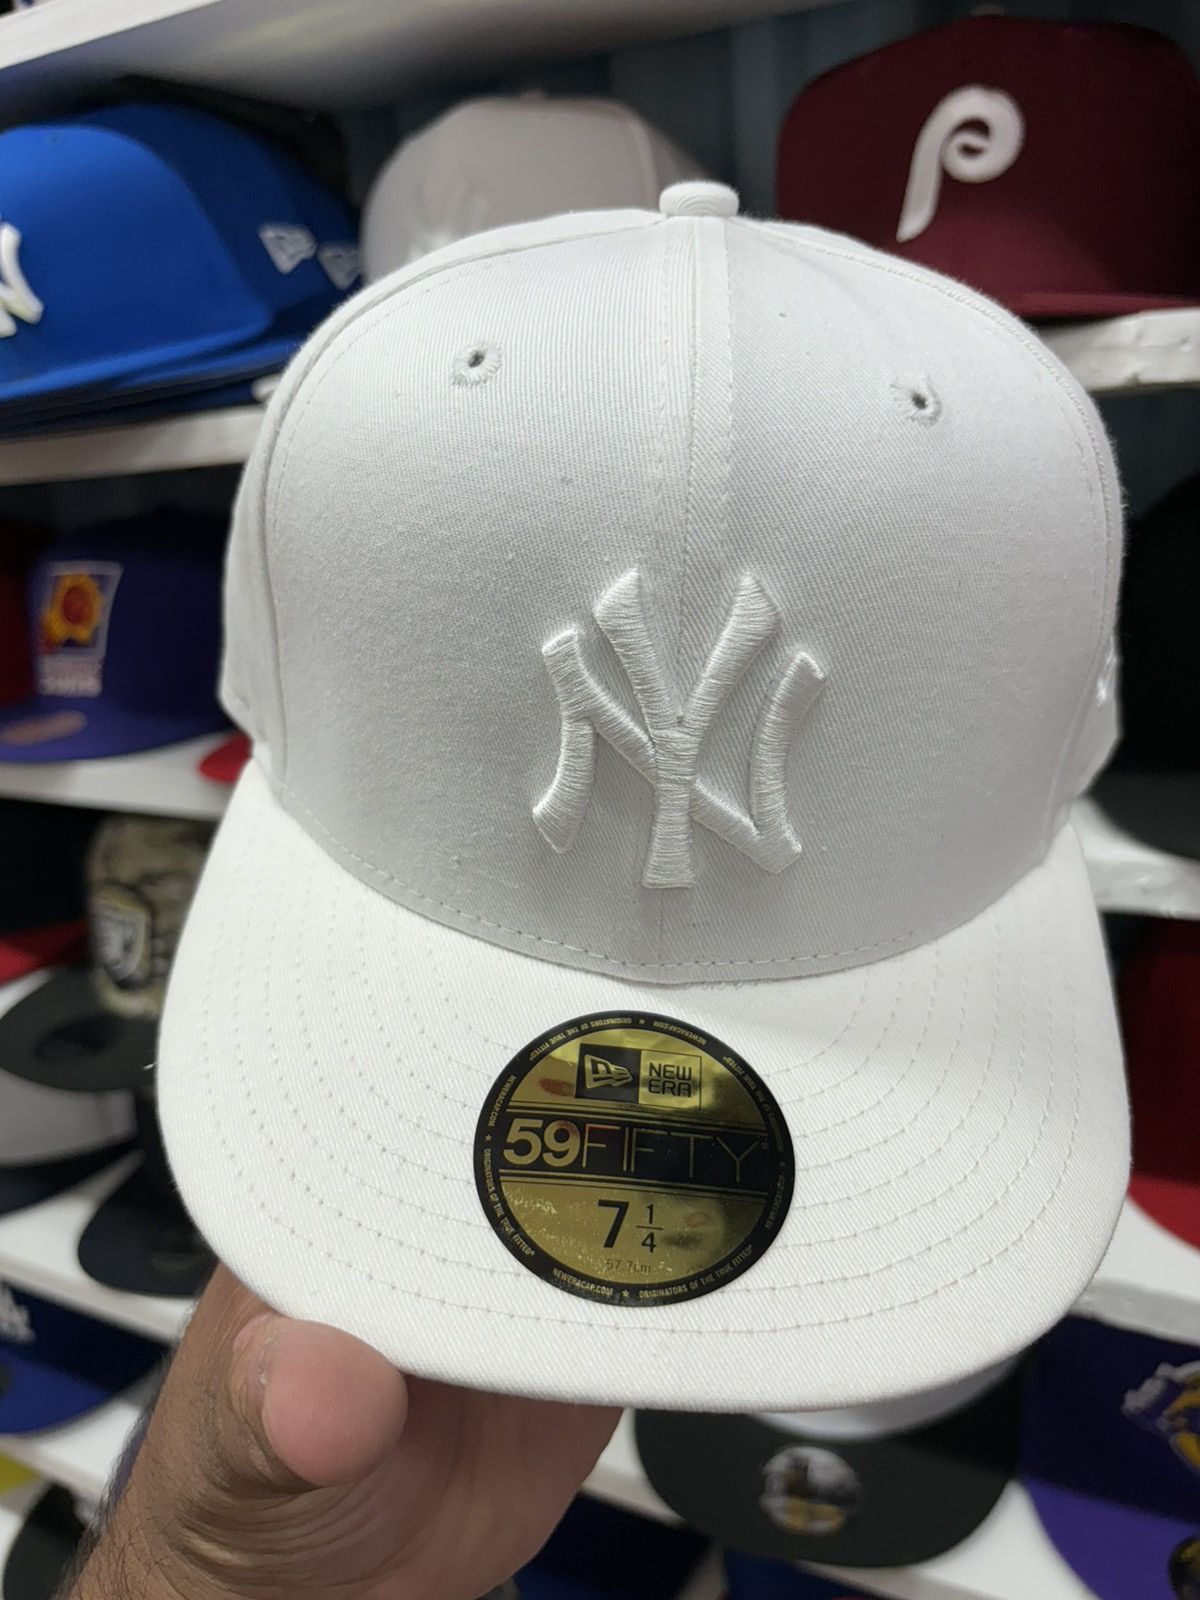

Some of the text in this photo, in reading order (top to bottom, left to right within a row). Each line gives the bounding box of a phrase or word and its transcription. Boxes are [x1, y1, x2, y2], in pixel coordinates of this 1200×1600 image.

[896, 84, 1025, 243] P
[532, 566, 824, 889] NY
[647, 1079, 692, 1098] ERA
[648, 1061, 692, 1081] NEW
